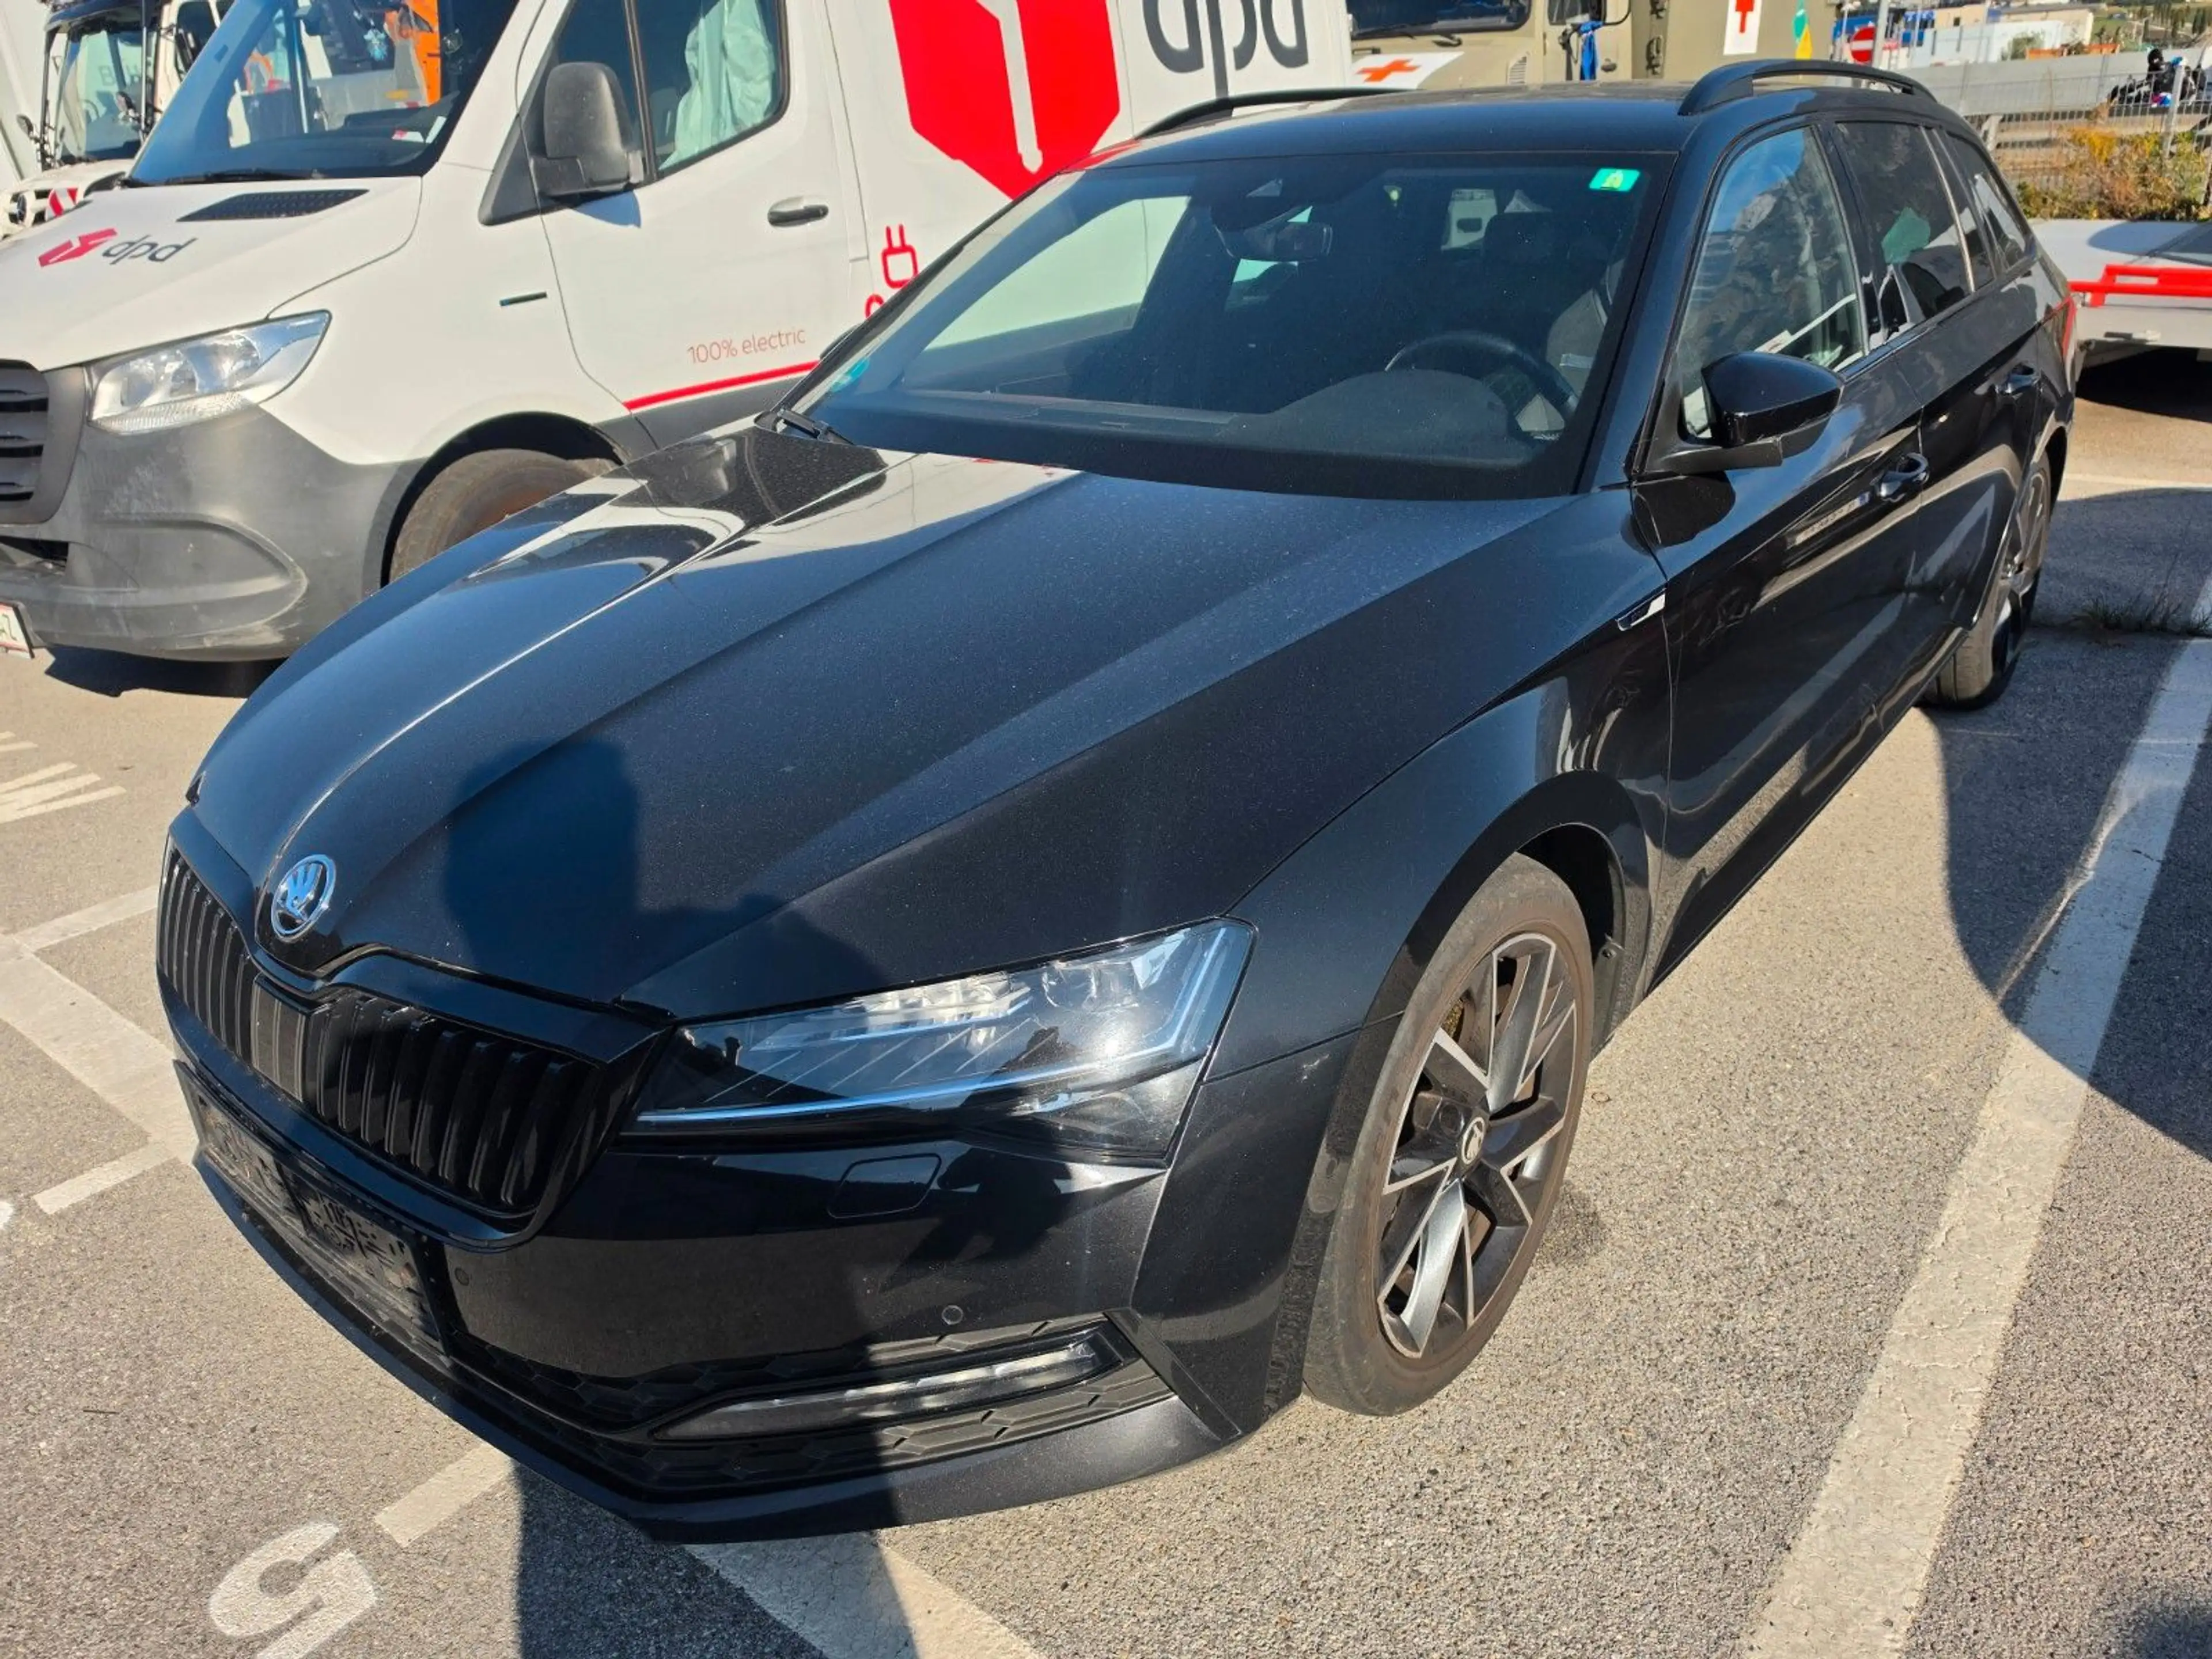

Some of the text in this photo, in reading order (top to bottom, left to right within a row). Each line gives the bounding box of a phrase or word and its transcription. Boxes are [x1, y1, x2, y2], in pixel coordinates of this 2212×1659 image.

[102, 234, 198, 265] dpd
[687, 329, 806, 363] 100% electric
